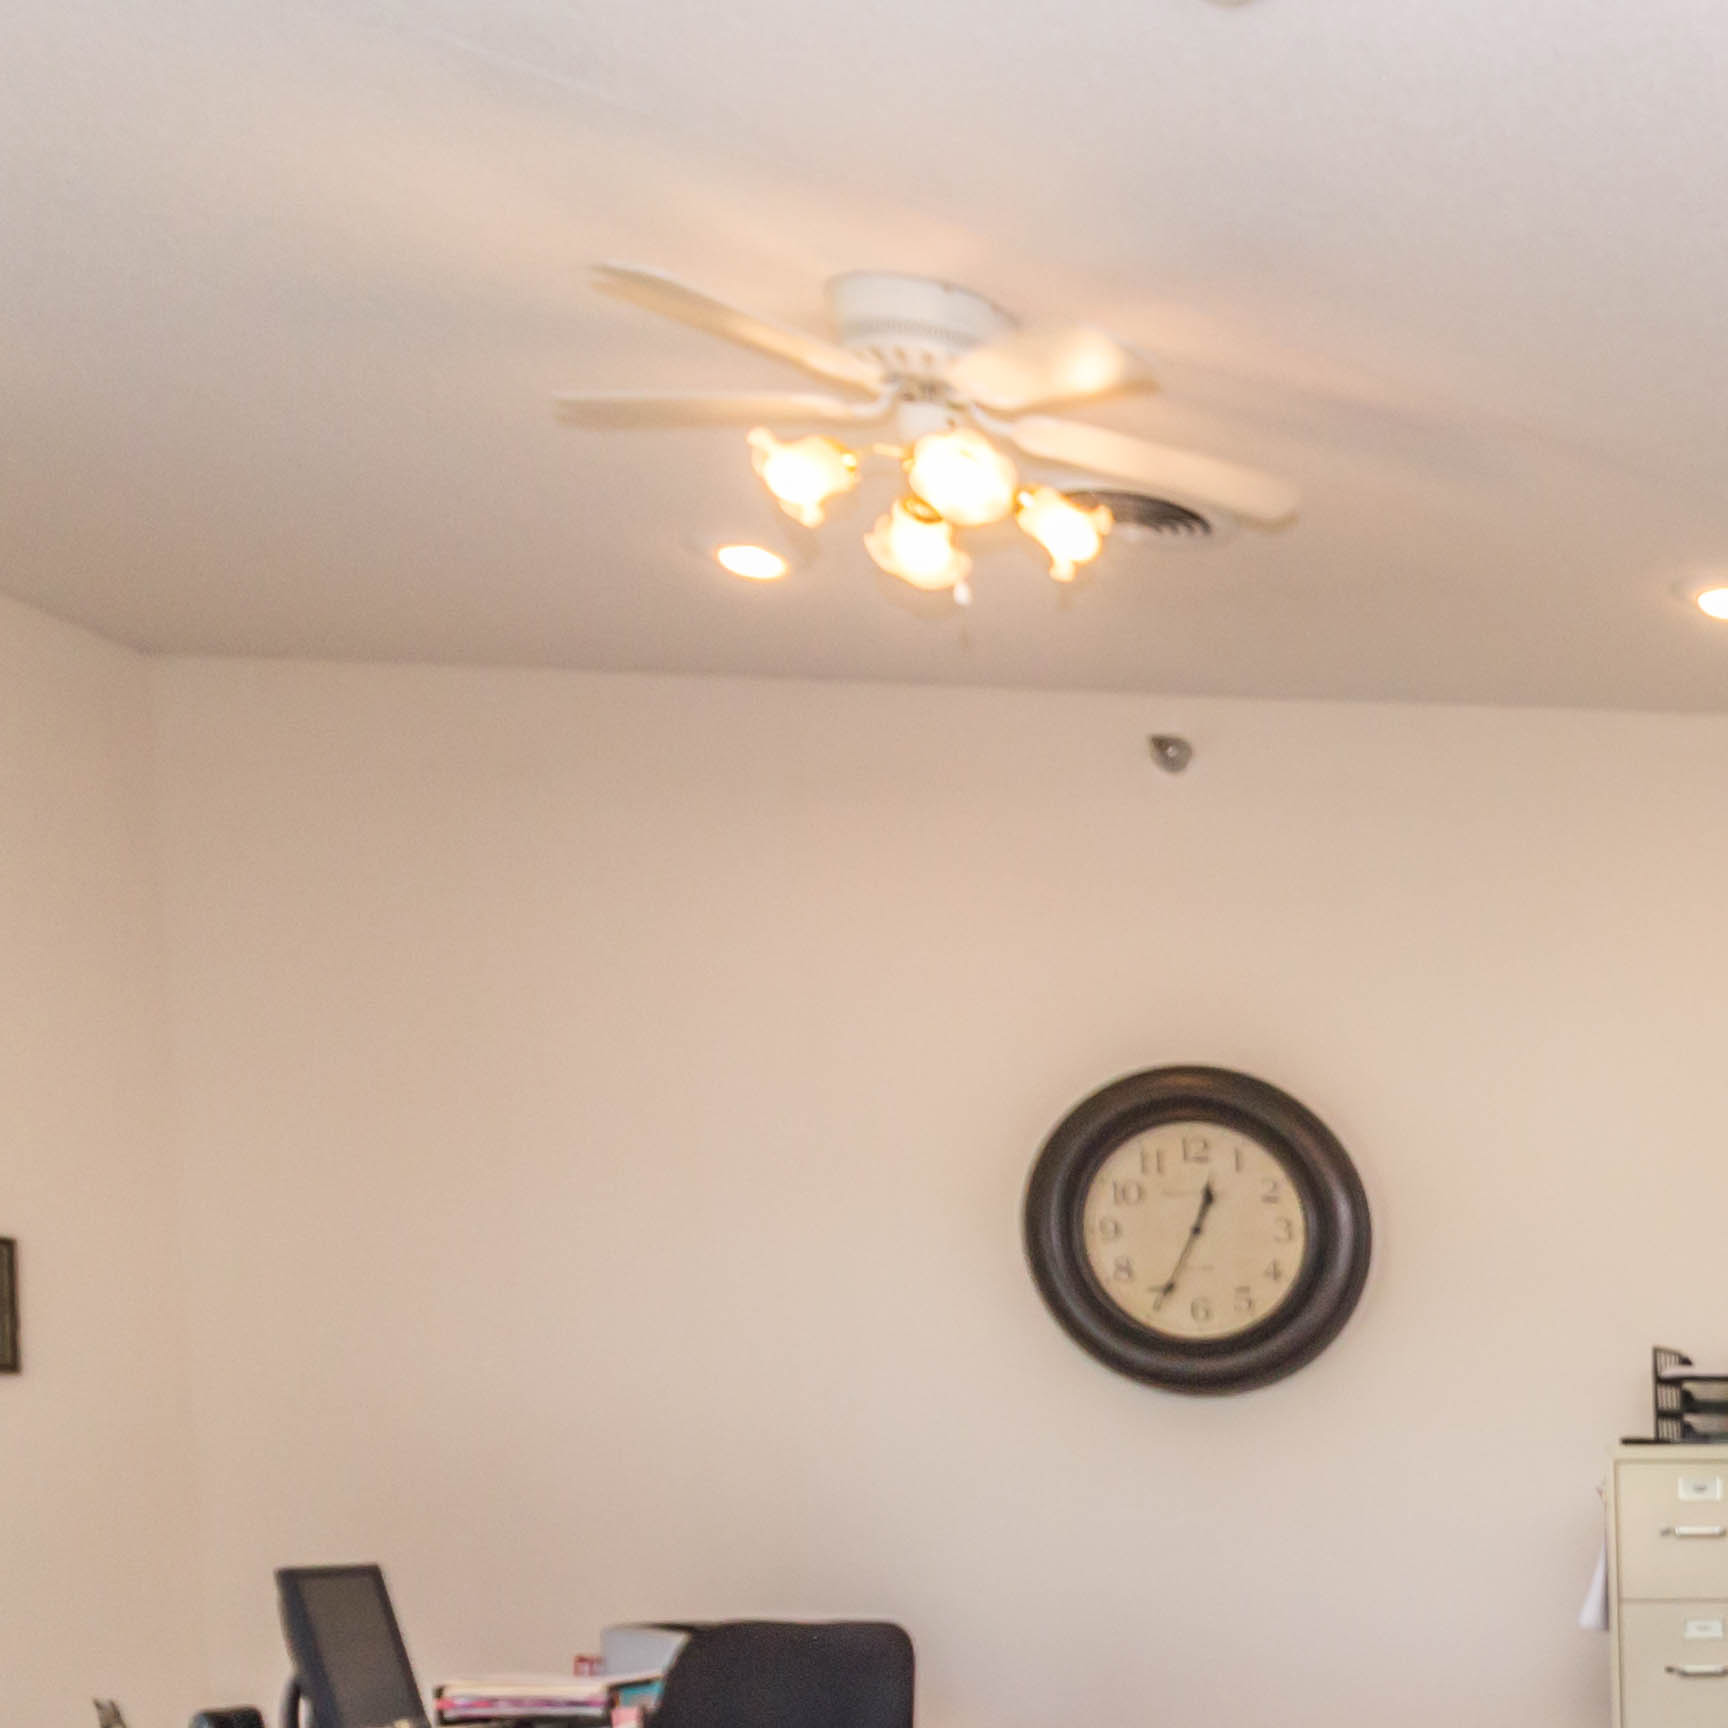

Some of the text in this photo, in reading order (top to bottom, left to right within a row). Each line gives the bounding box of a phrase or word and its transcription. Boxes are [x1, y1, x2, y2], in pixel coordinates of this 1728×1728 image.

[1140, 1149, 1164, 1174] 11
[1182, 1136, 1210, 1163] 12
[1233, 1147, 1243, 1172] 1
[1113, 1181, 1146, 1205] 10
[1261, 1179, 1279, 1203] 2
[1100, 1218, 1121, 1242] 9
[1274, 1217, 1294, 1242] 3
[1113, 1256, 1135, 1282] 8
[1262, 1258, 1282, 1282] 4
[1191, 1296, 1214, 1321] 6
[1234, 1285, 1254, 1311] 5
